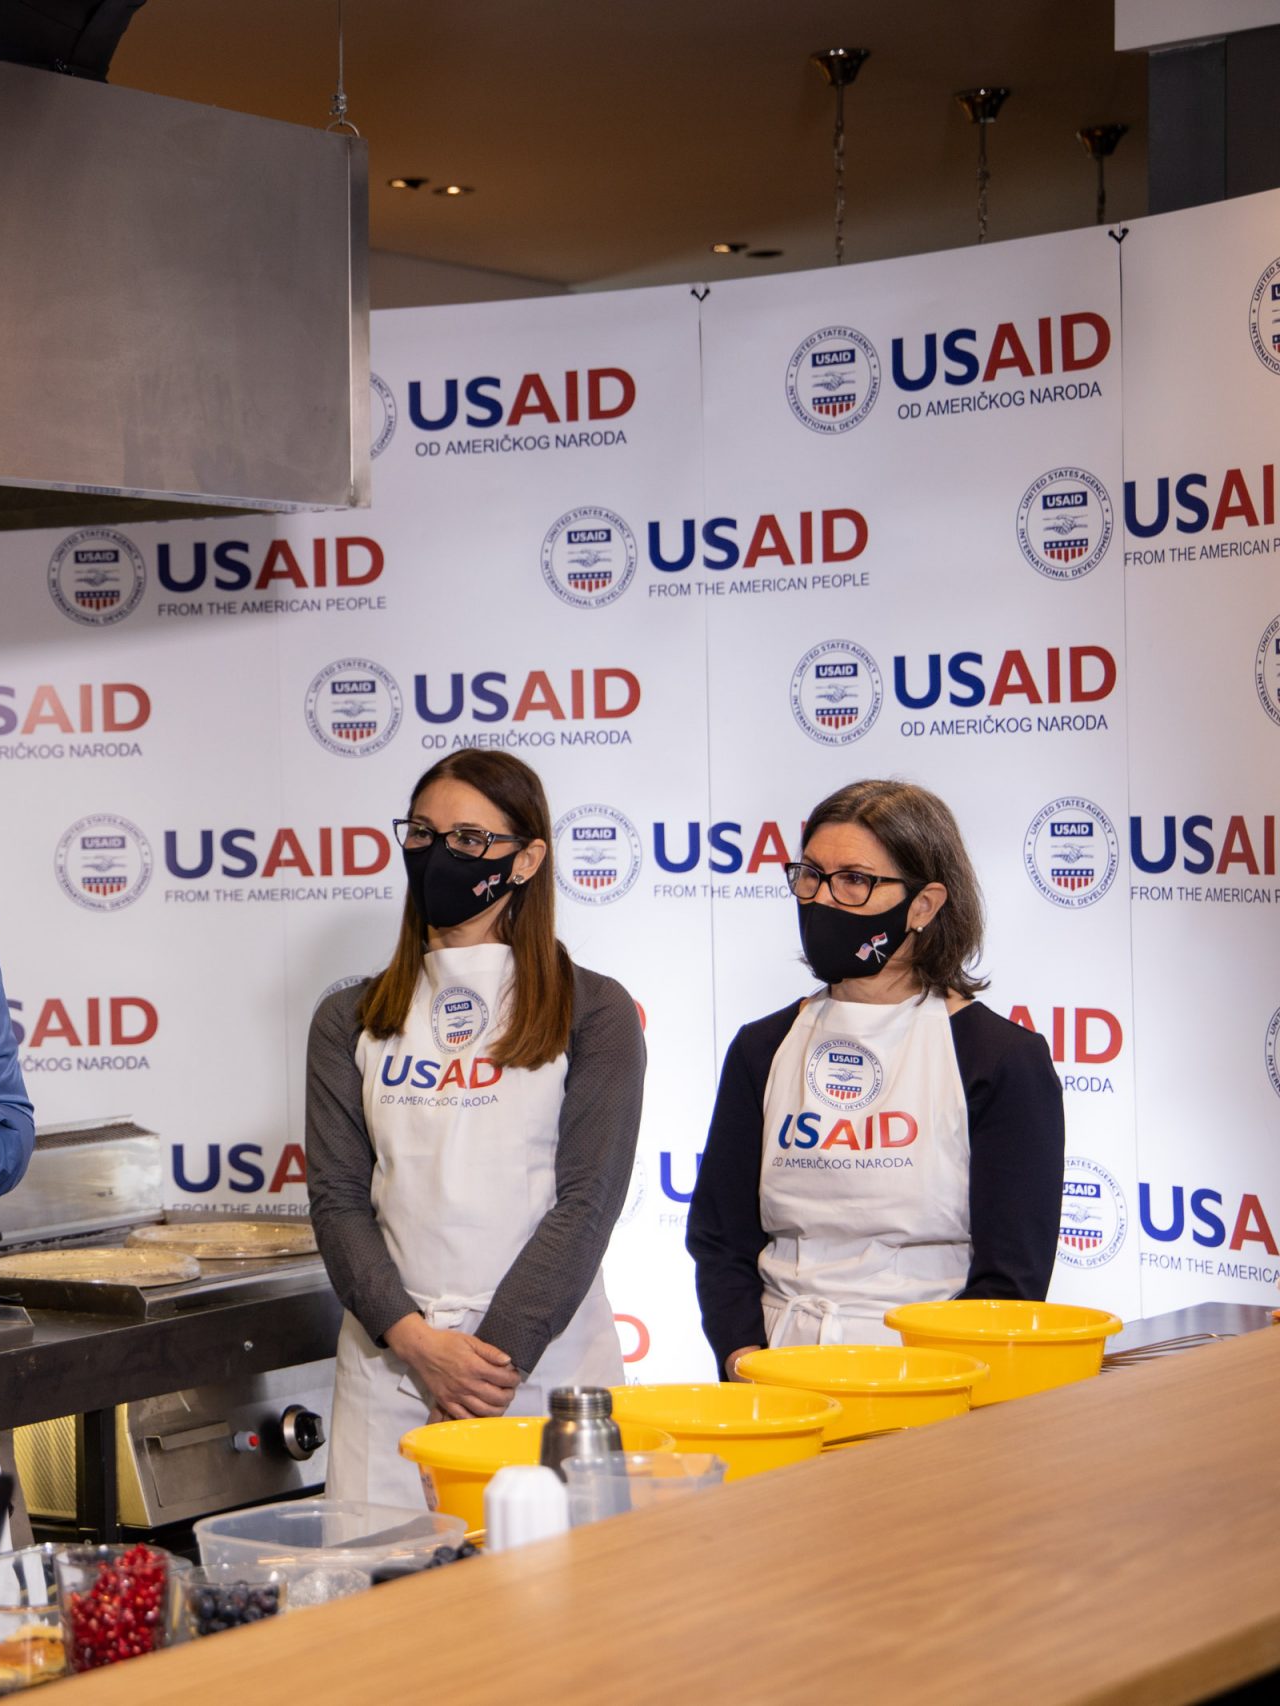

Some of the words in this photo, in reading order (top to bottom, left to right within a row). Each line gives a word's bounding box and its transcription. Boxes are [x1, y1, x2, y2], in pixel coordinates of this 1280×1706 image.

[1254, 267, 1274, 301] UNITED
[792, 338, 816, 367] UNITED
[817, 330, 846, 339] STATES
[848, 332, 874, 358] AGENCY
[816, 352, 851, 364] USAID
[892, 312, 1111, 391] USAID
[1252, 322, 1280, 371] INTERNATIO
[409, 368, 635, 430] USAID
[898, 404, 921, 419] OD
[926, 391, 1024, 416] AMERIČKOG
[1030, 382, 1102, 404] NARODA
[416, 442, 440, 456] OD
[446, 434, 549, 454] AMERIČKOG
[556, 431, 627, 448] NARODA
[1023, 479, 1047, 509] UNITED
[1048, 470, 1079, 480] STATES
[1080, 474, 1107, 502] AGENCY
[1047, 494, 1082, 506] USAID
[1124, 464, 1274, 538] USAI
[573, 509, 602, 518] STATES
[571, 532, 607, 541] USAID
[648, 508, 868, 572] USAID
[1020, 528, 1069, 577] INTERNATIONAL
[1072, 521, 1111, 576] DEVELOPMENT
[78, 553, 115, 561] USAID
[157, 537, 384, 593] USAID
[1125, 551, 1165, 566] FROM
[1170, 547, 1195, 561] THE
[1200, 540, 1269, 559] AMERICAN
[649, 583, 692, 597] FROM
[696, 582, 725, 595] THE
[729, 577, 808, 593] AMERICAN
[812, 573, 870, 588] PEOPLE
[158, 603, 202, 616] FROM
[206, 602, 237, 615] THE
[241, 599, 320, 614] AMERICAN
[326, 597, 386, 611] PEOPLE
[1260, 621, 1279, 652] UNITED
[821, 643, 849, 651] STATES
[851, 646, 876, 673] AGENCY
[820, 666, 853, 676] USAID
[894, 646, 1117, 709] USAID
[335, 683, 371, 692] USAID
[414, 668, 641, 724] USAID
[1258, 673, 1280, 722] INTERNATI
[900, 721, 925, 736] OD
[930, 715, 1031, 736] AMERIČKOG
[1037, 715, 1108, 731] NARODA
[70, 743, 143, 758] NARODA
[422, 735, 447, 749] OD
[452, 730, 555, 748] AMERIČKOG
[561, 730, 632, 746] NARODA
[579, 807, 608, 815] STATES
[1030, 806, 1054, 835] UNITED
[1056, 800, 1085, 808] STATES
[1086, 804, 1112, 834] AGENCY
[576, 829, 612, 839] USAID
[1054, 825, 1089, 835] USAID
[164, 827, 391, 879] USAID
[653, 821, 805, 873] USA
[1130, 815, 1275, 875] USAI
[1027, 853, 1075, 905] INTERNATIONAL
[1078, 853, 1116, 905] DEVELOPMENT
[165, 890, 209, 903] FROM
[213, 890, 244, 902] THE
[248, 888, 327, 901] AMERICAN
[332, 887, 393, 899] PEOPLE
[654, 885, 696, 898] FROM
[702, 885, 733, 898] THE
[735, 885, 793, 899] AMERIC
[1131, 887, 1172, 900] FROM
[1177, 887, 1201, 901] THE
[1205, 888, 1271, 903] AMERICAN
[447, 1003, 468, 1012] USAID
[6, 998, 158, 1047] AID
[77, 1056, 149, 1070] NARODA
[815, 1042, 832, 1059] UNITED
[833, 1055, 859, 1063] USAID
[1064, 1076, 1114, 1093] RODA
[380, 1095, 394, 1104] OD
[398, 1096, 458, 1107] AMERIČKOG
[172, 1144, 306, 1193] USA
[784, 1155, 851, 1169] AMERIČKOG
[856, 1158, 913, 1168] NARODA
[1065, 1160, 1091, 1169] TATES
[1093, 1166, 1120, 1197] AGENCY
[256, 1204, 310, 1216] AMERIC
[1139, 1183, 1280, 1255] USA
[1140, 1253, 1181, 1270] FROM
[1186, 1258, 1213, 1274] THE
[1217, 1262, 1280, 1283] AMERICA
